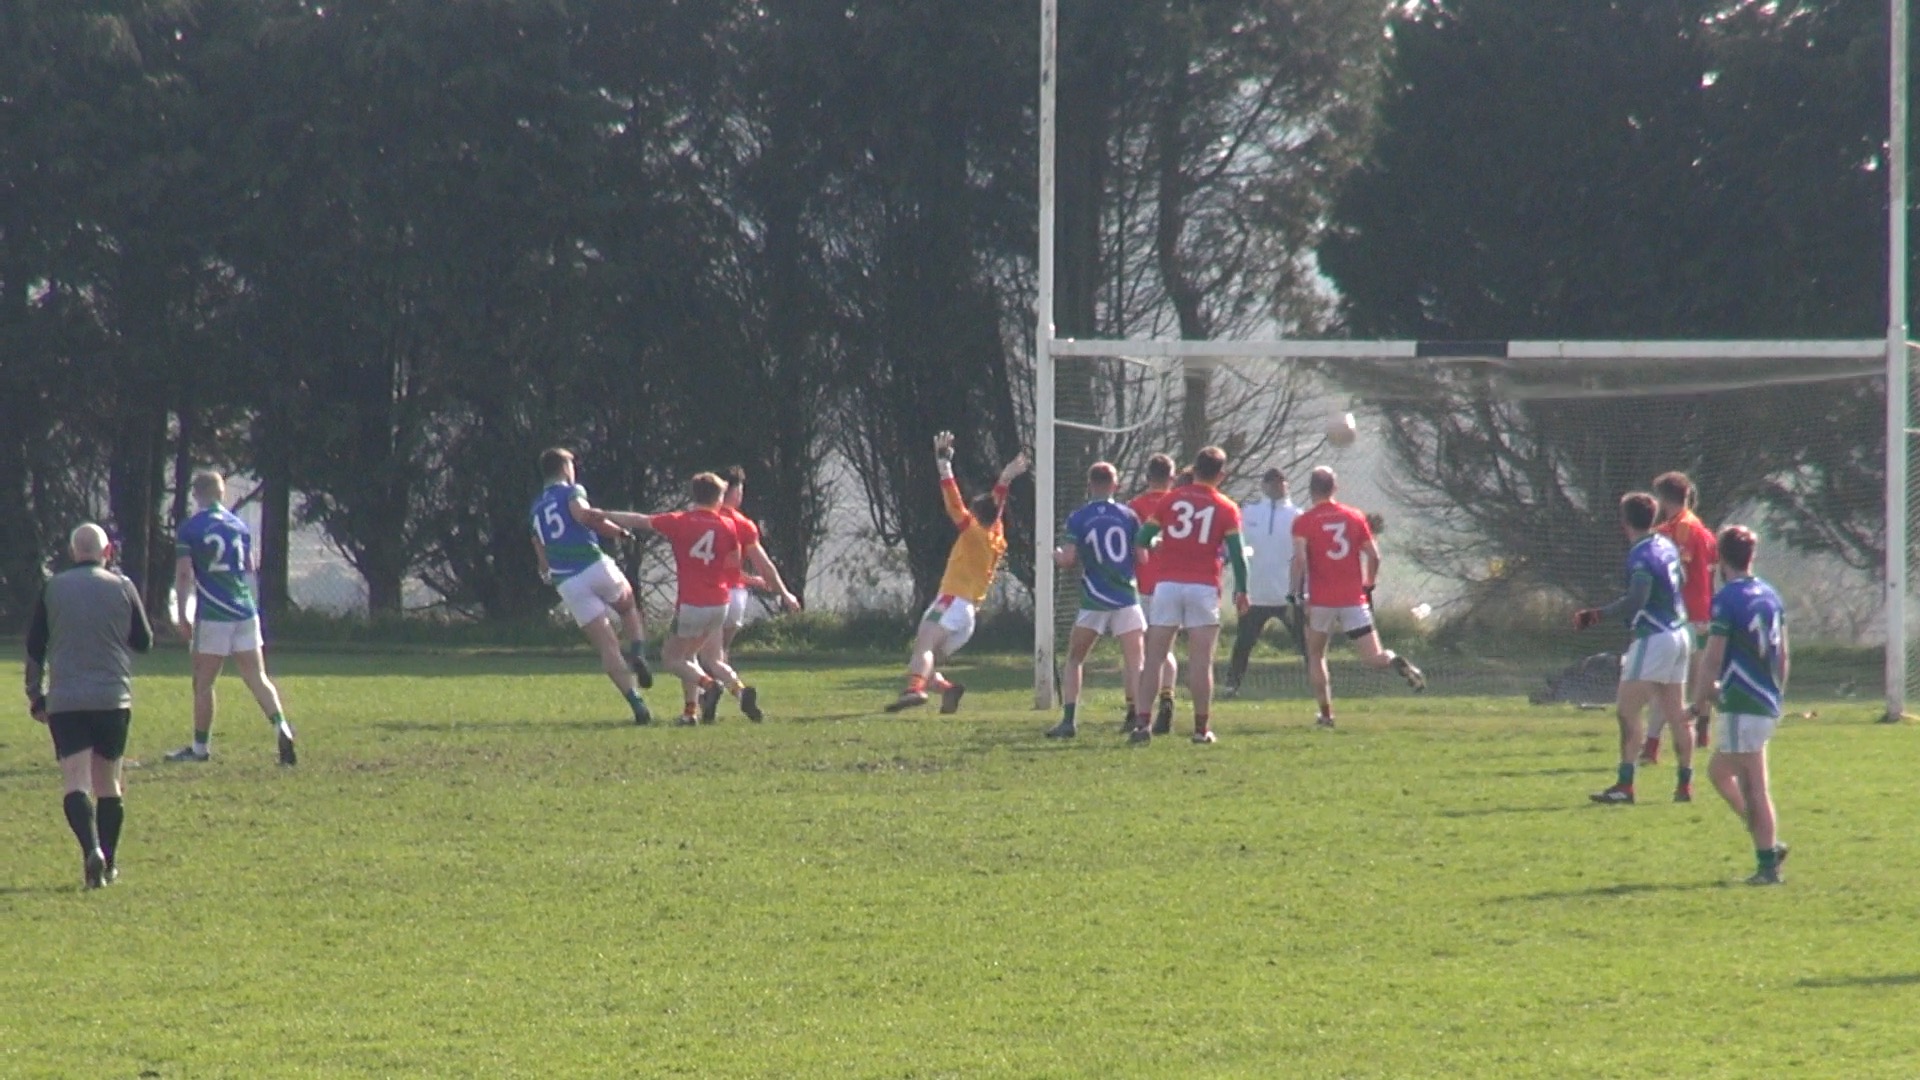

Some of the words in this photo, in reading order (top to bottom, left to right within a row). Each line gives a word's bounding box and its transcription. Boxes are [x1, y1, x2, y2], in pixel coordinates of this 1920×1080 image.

[533, 502, 565, 546] 15
[1168, 500, 1215, 544] 31
[203, 533, 245, 571] 21
[689, 529, 715, 565] 4
[1085, 526, 1127, 564] 10
[1322, 523, 1350, 560] 3
[1748, 612, 1781, 658] 14
